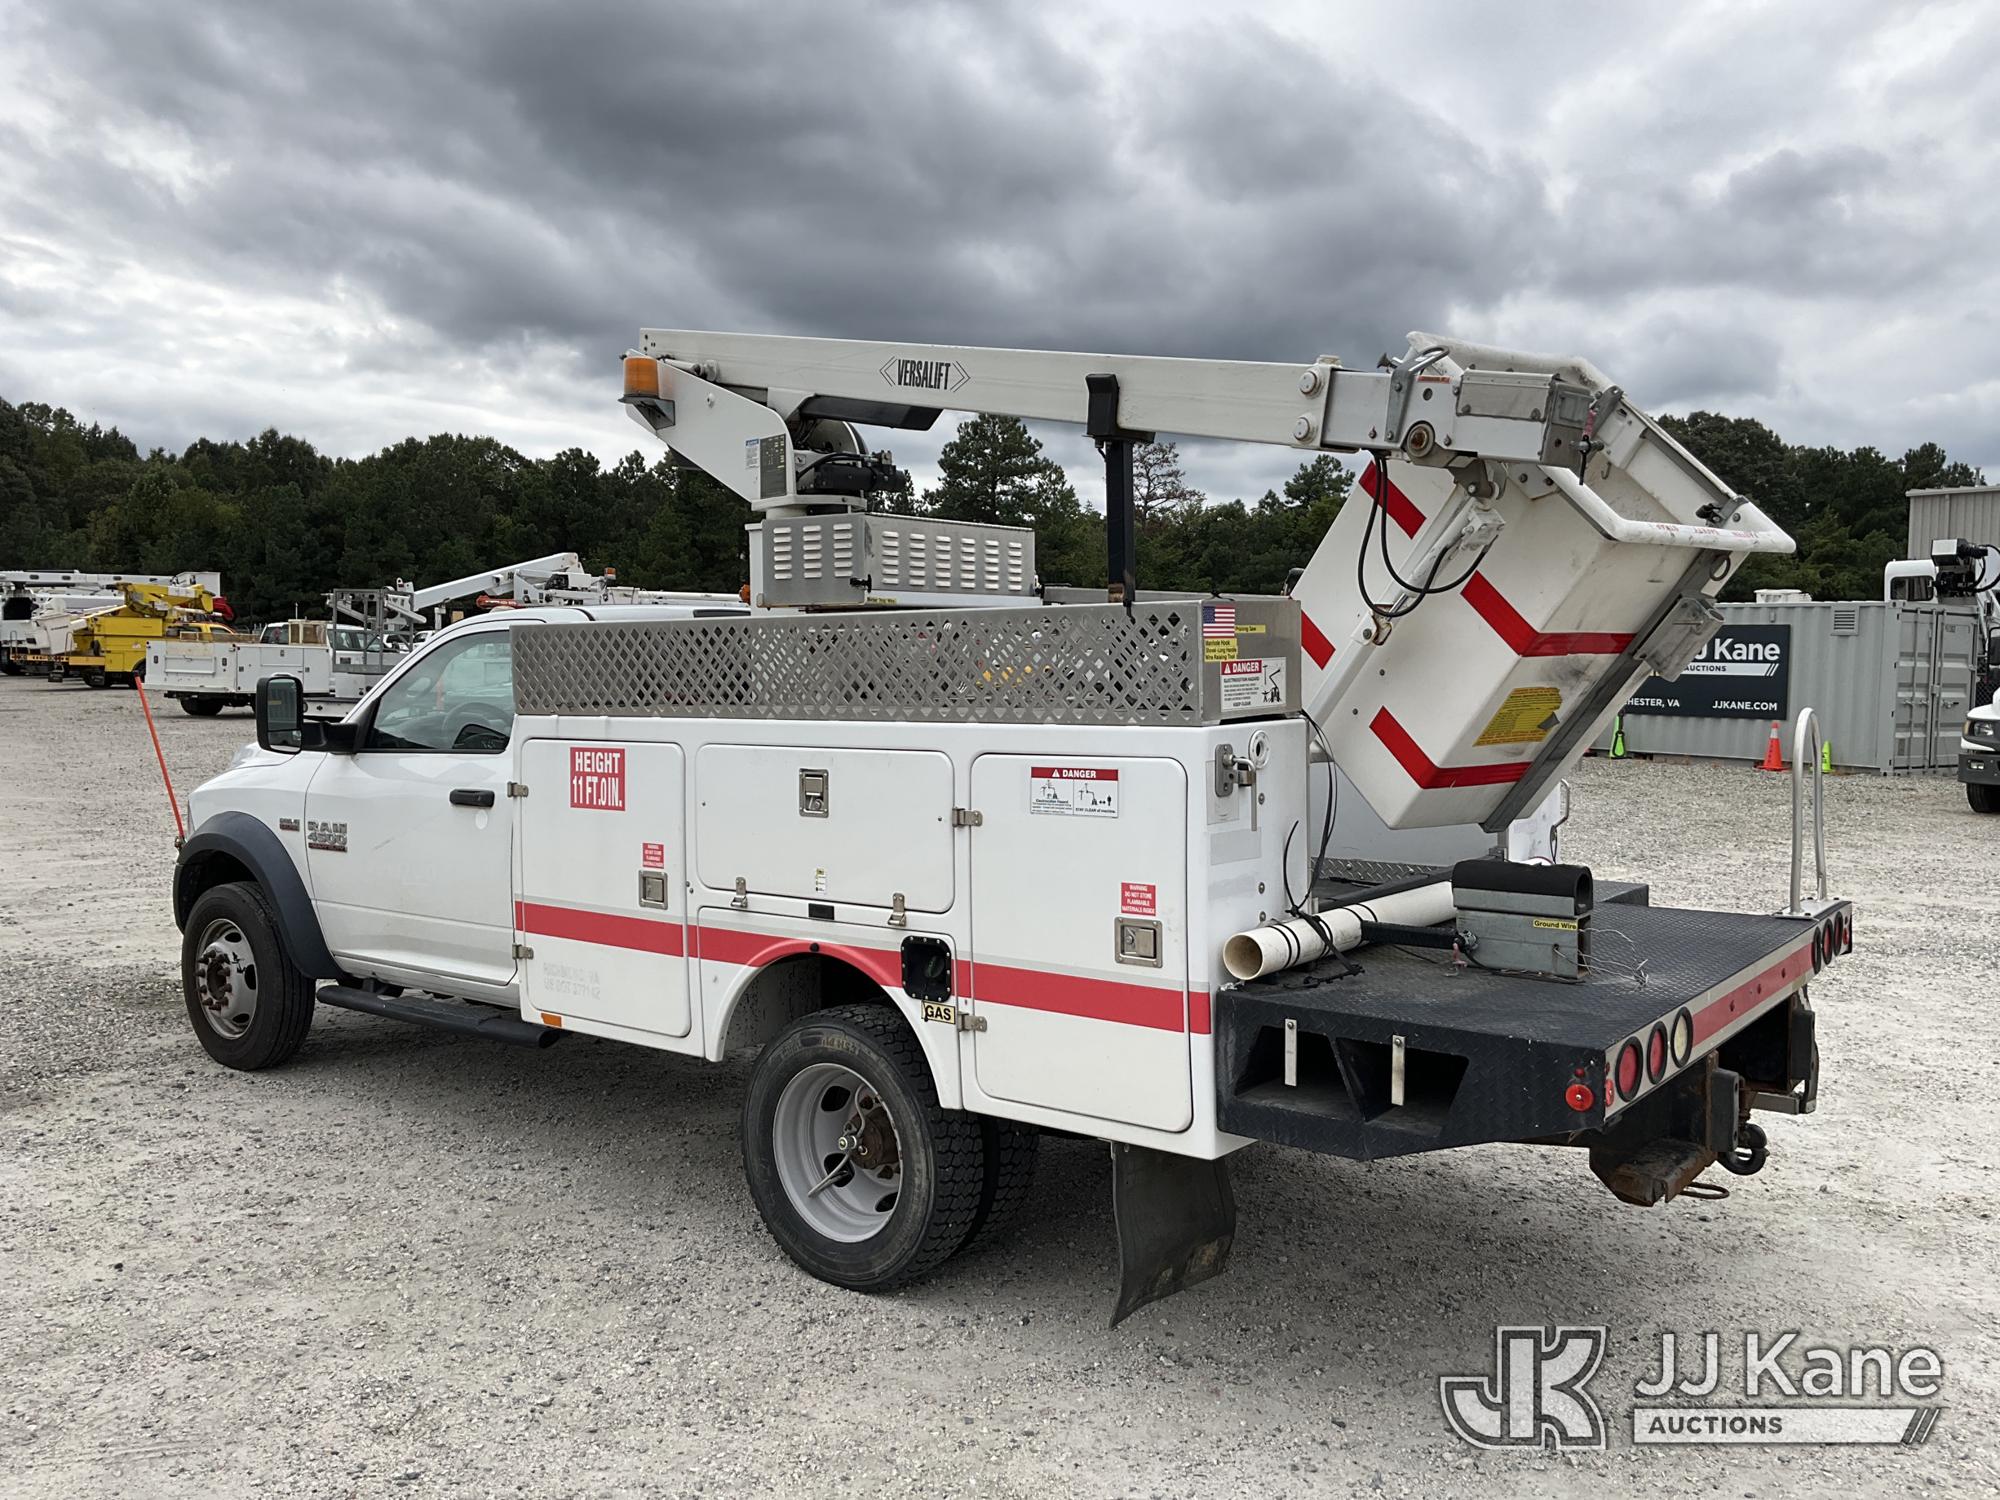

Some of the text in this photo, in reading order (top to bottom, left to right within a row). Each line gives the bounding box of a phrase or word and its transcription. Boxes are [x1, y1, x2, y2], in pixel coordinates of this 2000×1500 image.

[897, 358, 951, 391] VERSALIFT
[1714, 638, 1781, 661] Kane
[1232, 662, 1260, 672] DANGER
[1625, 697, 1680, 709] HESTER, VA
[1712, 700, 1778, 711] JJKANE.COM
[575, 751, 621, 774] HEIGHT
[1062, 769, 1097, 779] DANGER
[572, 775, 583, 804] 11
[307, 821, 348, 834] RAM
[307, 832, 348, 846] 4500
[1534, 920, 1577, 930] Ground Wire
[925, 1004, 952, 1021] GAS
